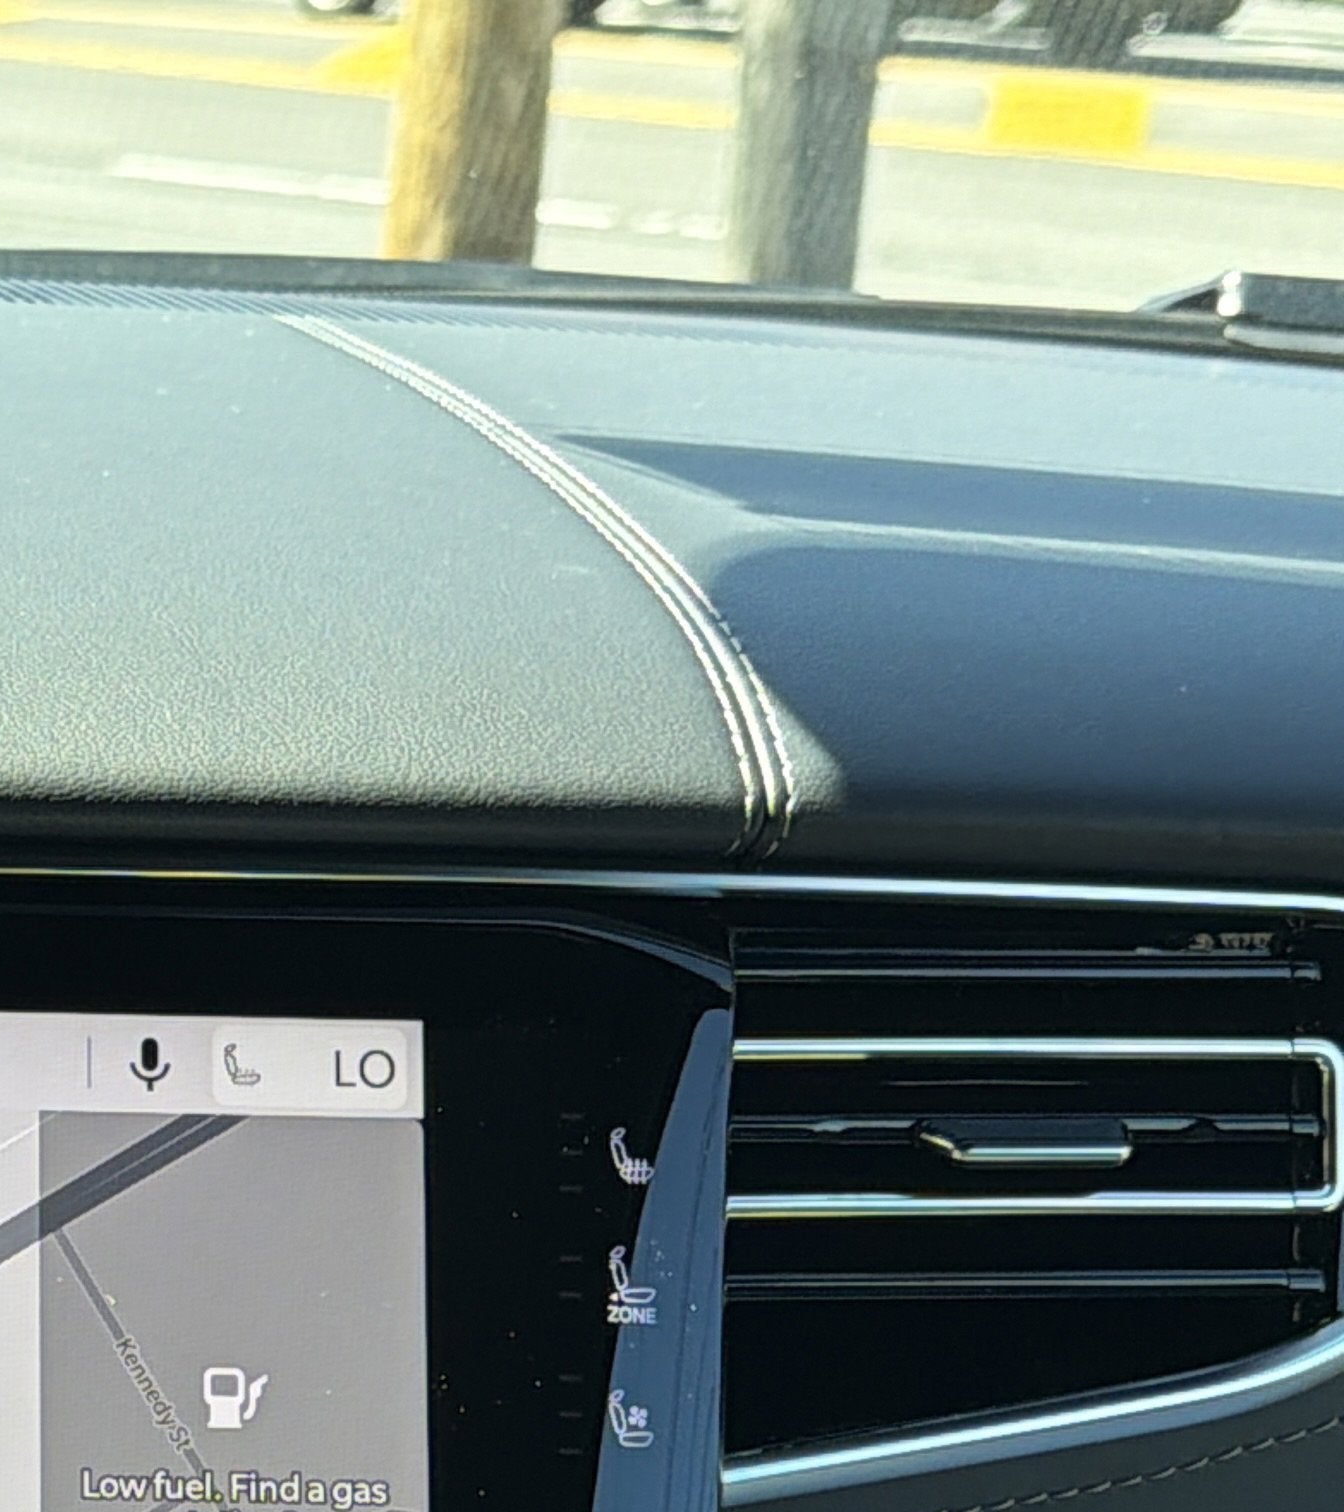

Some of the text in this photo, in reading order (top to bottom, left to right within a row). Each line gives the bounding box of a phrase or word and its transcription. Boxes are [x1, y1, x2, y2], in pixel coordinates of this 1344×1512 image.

[334, 1049, 396, 1089] LO
[606, 1304, 658, 1325] ZONE
[115, 1338, 191, 1452] Kennedy St
[82, 1471, 388, 1508] Low fuel. Find a gas
